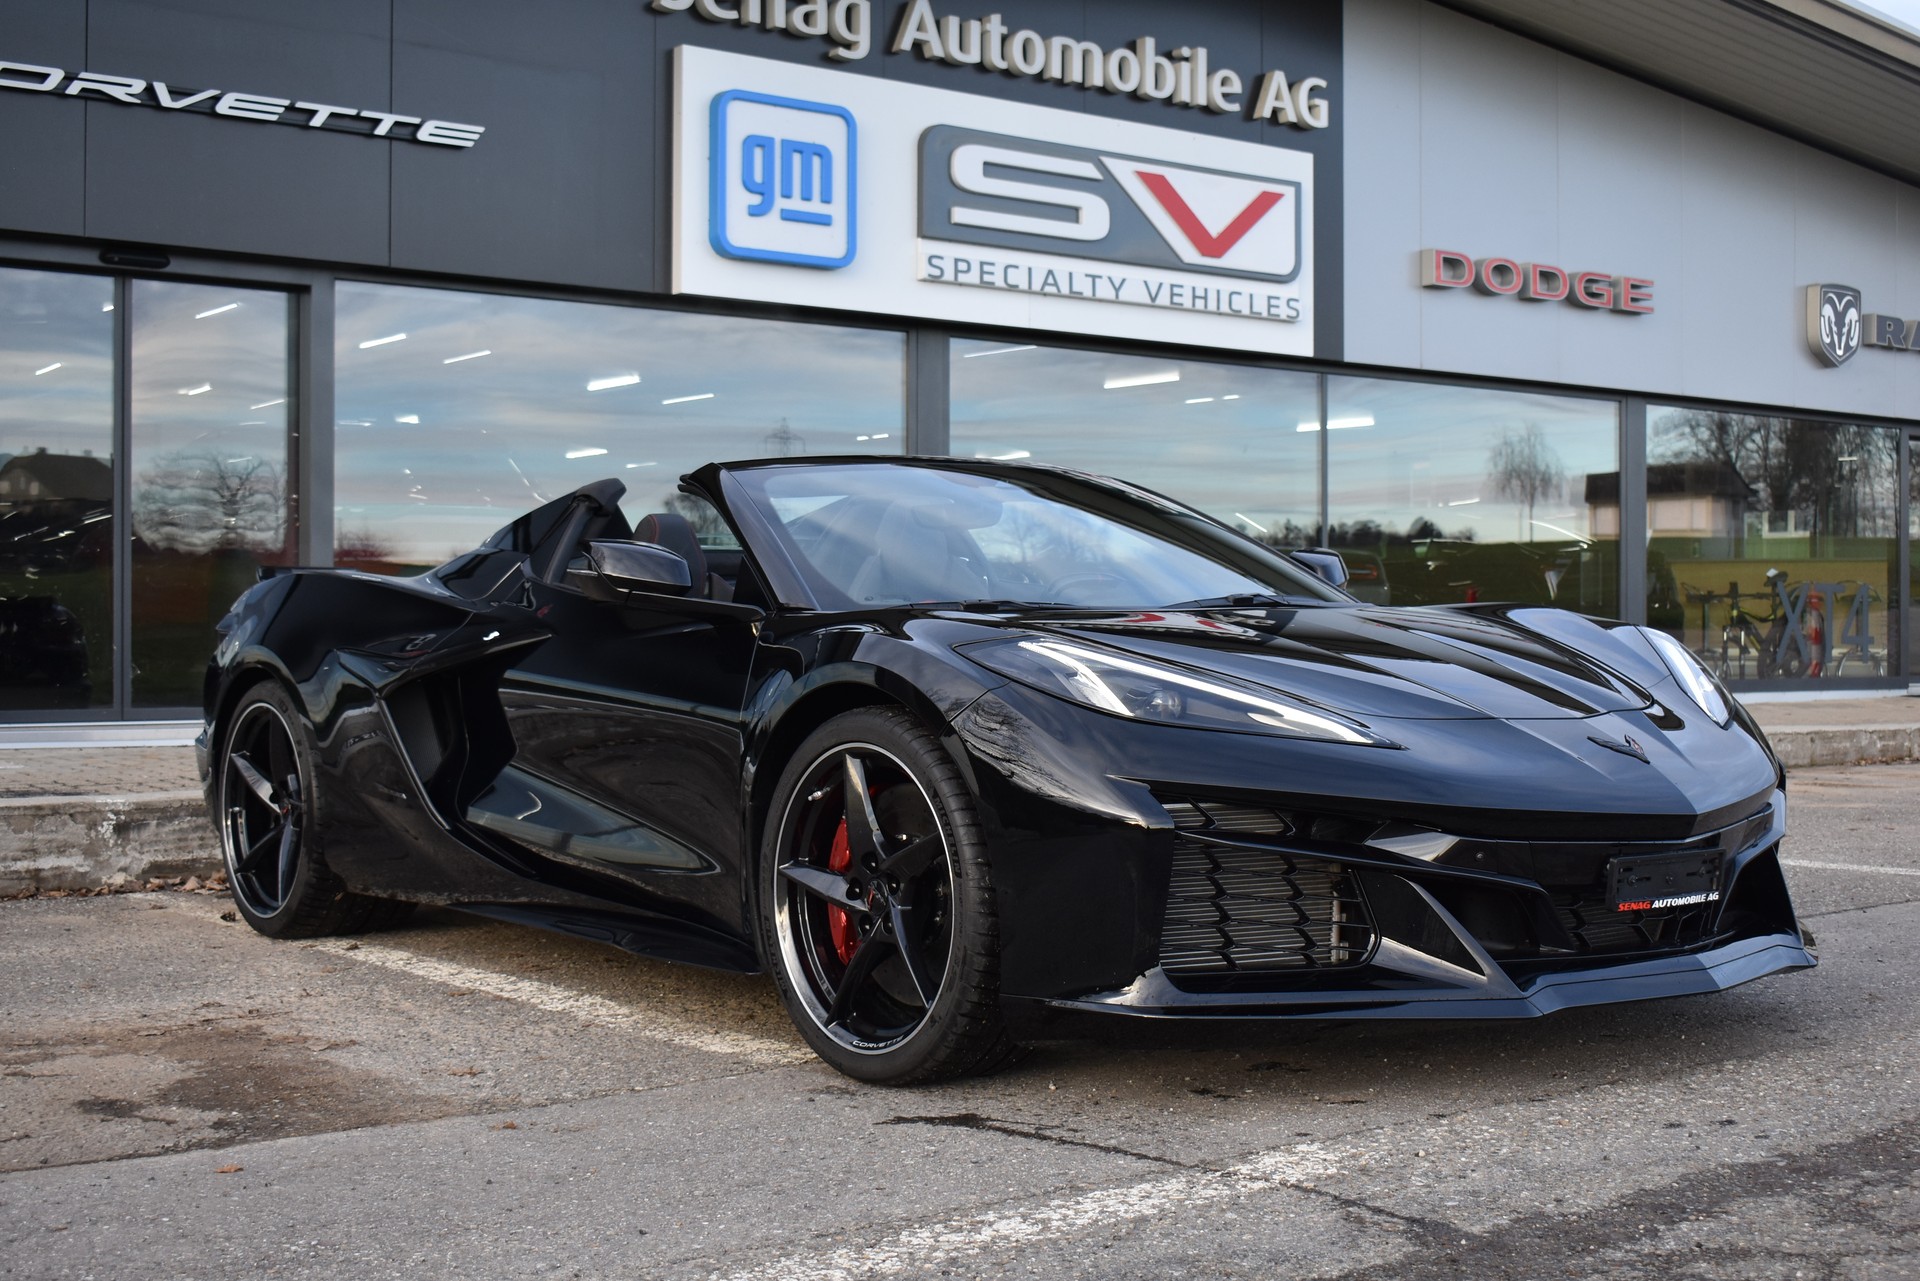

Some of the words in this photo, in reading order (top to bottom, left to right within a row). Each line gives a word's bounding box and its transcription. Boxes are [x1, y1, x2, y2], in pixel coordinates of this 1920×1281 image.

[0, 60, 486, 148] ORVETTE
[651, 0, 872, 60] nag
[893, 0, 1242, 113] Automobile
[1253, 70, 1329, 129] AG
[741, 134, 834, 218] gm
[950, 143, 1286, 259] SV
[925, 254, 1128, 303] SPECIALTY
[1143, 279, 1302, 321] VEHICLES
[1430, 249, 1655, 315] DODGE
[1776, 580, 1875, 664] XT4
[1617, 901, 1651, 912] SENAG
[1652, 894, 1706, 909] AUTOMOBILE
[1707, 892, 1719, 901] AG
